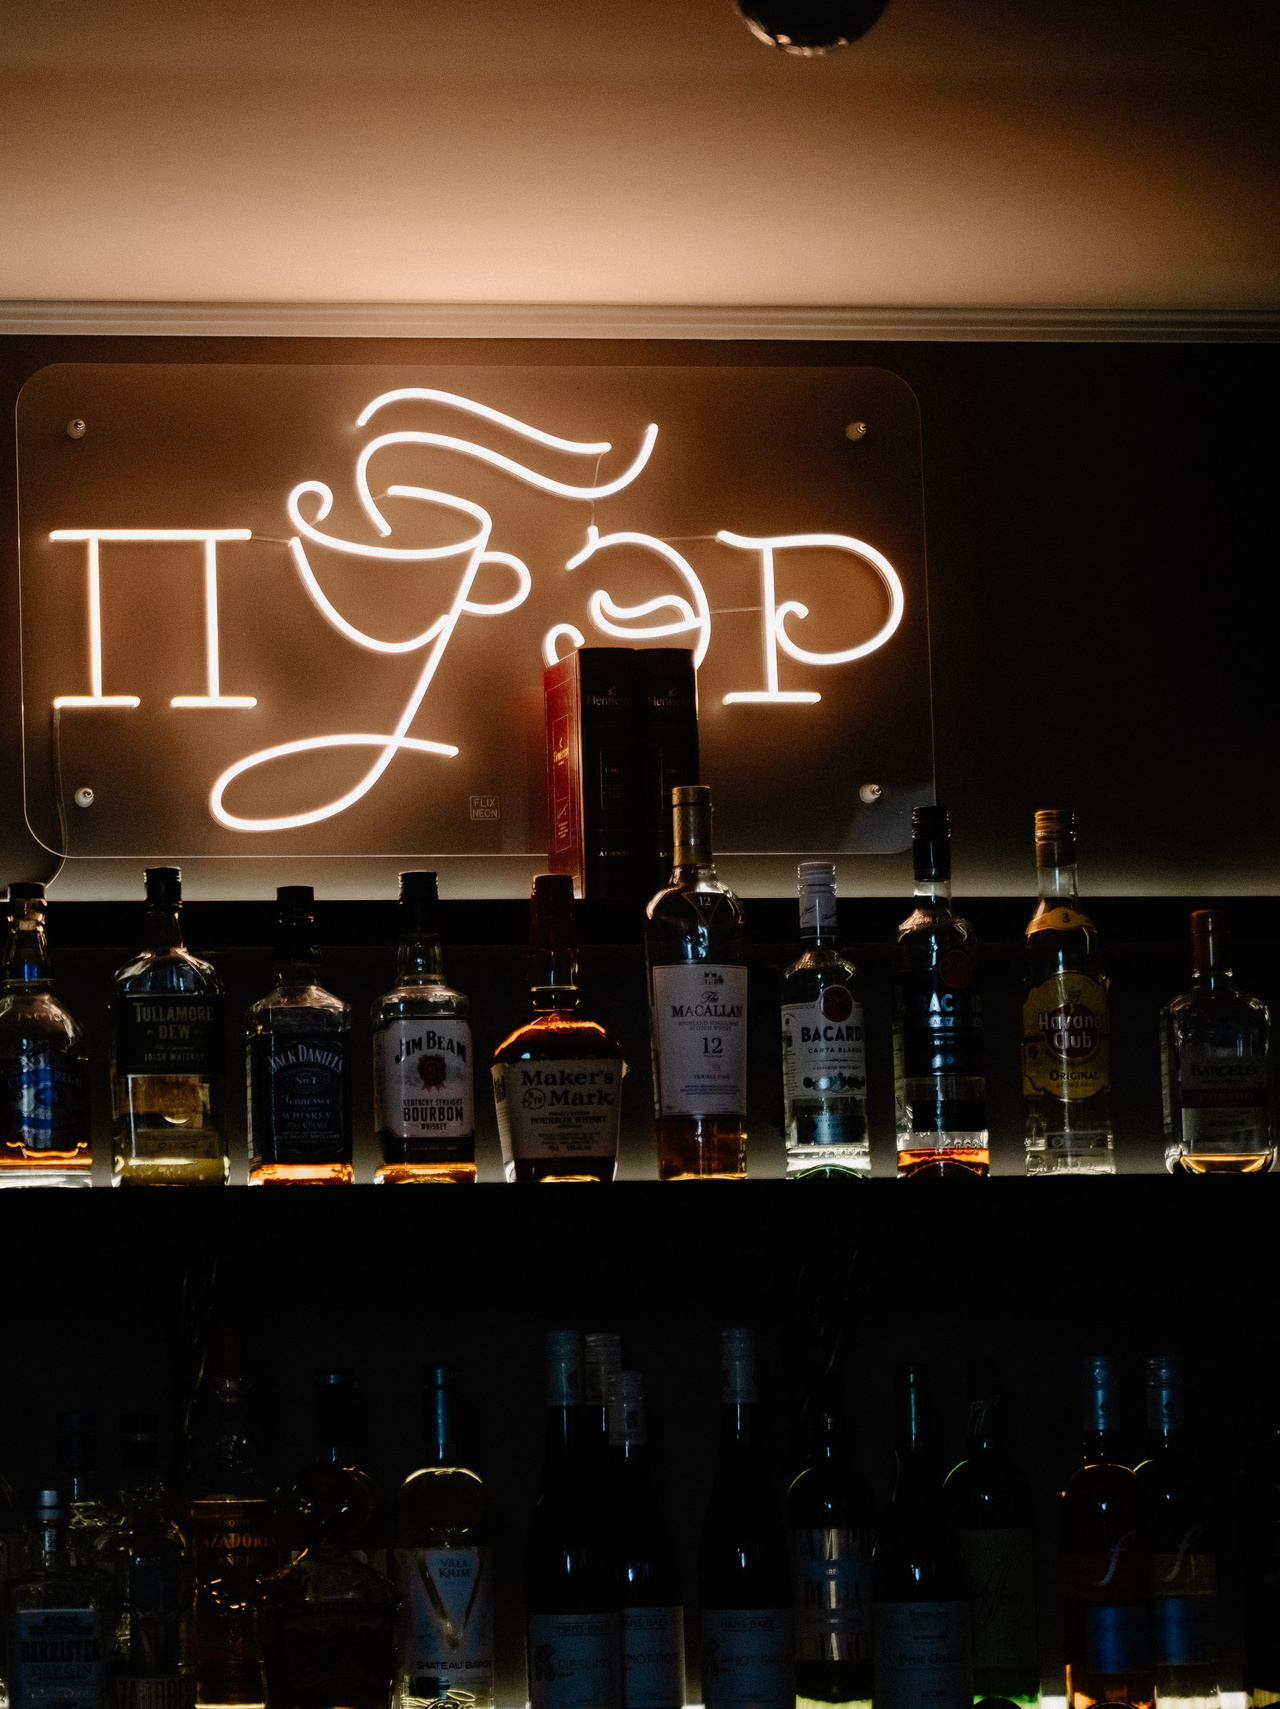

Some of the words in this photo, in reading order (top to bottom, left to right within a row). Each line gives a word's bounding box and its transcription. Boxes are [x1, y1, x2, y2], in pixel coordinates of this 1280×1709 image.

[587, 695, 629, 706] Hennes
[473, 797, 496, 808] FLIX
[473, 808, 498, 818] NEON
[132, 1002, 214, 1023] TULLAMORE
[672, 1005, 743, 1017] MACALLAN
[1039, 1012, 1101, 1031] Havana
[158, 1024, 190, 1040] DEW
[702, 1036, 723, 1054] 12
[1052, 1030, 1092, 1050] Club
[394, 1036, 423, 1064] JIM
[426, 1030, 466, 1063] BEAM
[144, 1053, 167, 1062] IRISH
[169, 1053, 205, 1062] WHISKEY
[268, 1048, 297, 1075] JACK
[521, 1070, 614, 1085] Maker's
[1049, 1069, 1099, 1081] ORIGINAL
[548, 1089, 614, 1106] Mark
[282, 1111, 332, 1120] WHISKEY
[403, 1106, 463, 1122] BOURBON
[531, 1116, 571, 1124] BOURBON
[421, 1122, 447, 1130] WHISKEY
[440, 1559, 468, 1567] VILLA
[438, 1568, 471, 1579] KRIM
